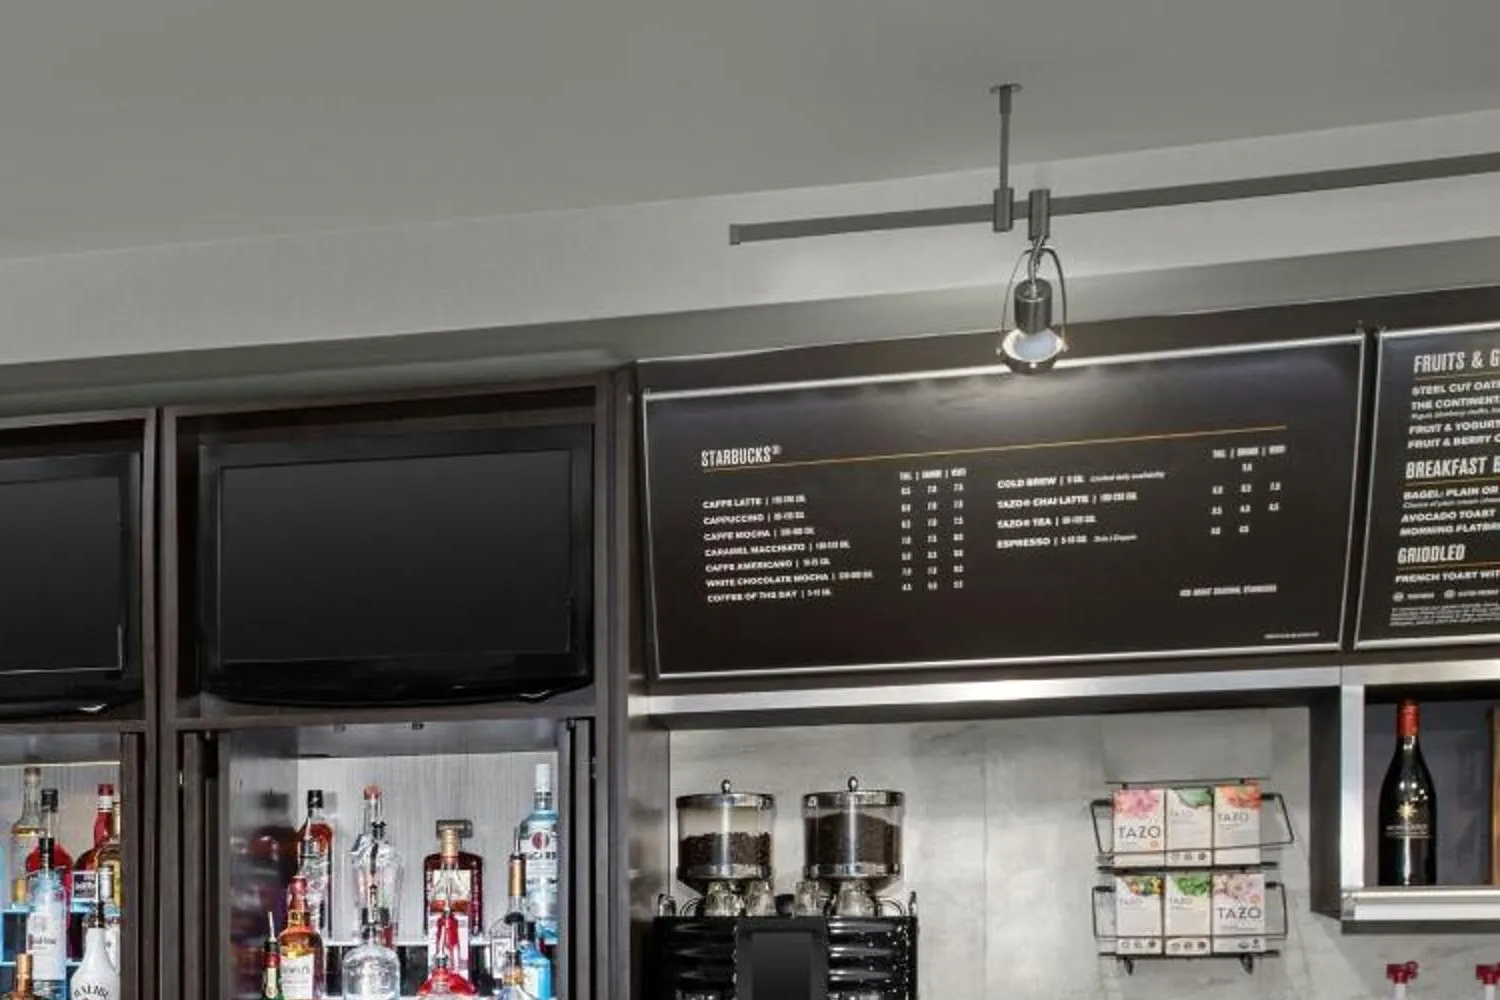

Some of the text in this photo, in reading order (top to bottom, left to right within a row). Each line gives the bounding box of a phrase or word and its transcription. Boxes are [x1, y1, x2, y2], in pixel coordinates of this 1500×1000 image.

[1413, 351, 1465, 373] FRUITS
[1471, 350, 1484, 368] &
[1412, 384, 1447, 396] STEEL
[1449, 382, 1471, 393] CUT
[1411, 400, 1433, 410] THE
[1407, 437, 1440, 449] FRUIT
[1405, 456, 1488, 479] BREAKFAST
[997, 479, 1024, 489] COLD
[1445, 487, 1480, 497] PLAIN
[1401, 511, 1457, 523] AVOCADO
[1397, 543, 1466, 564] GRIDDLED
[737, 574, 793, 585] CHOCOLATE
[1118, 825, 1161, 839] TAZO
[1218, 907, 1262, 920] TAZO
